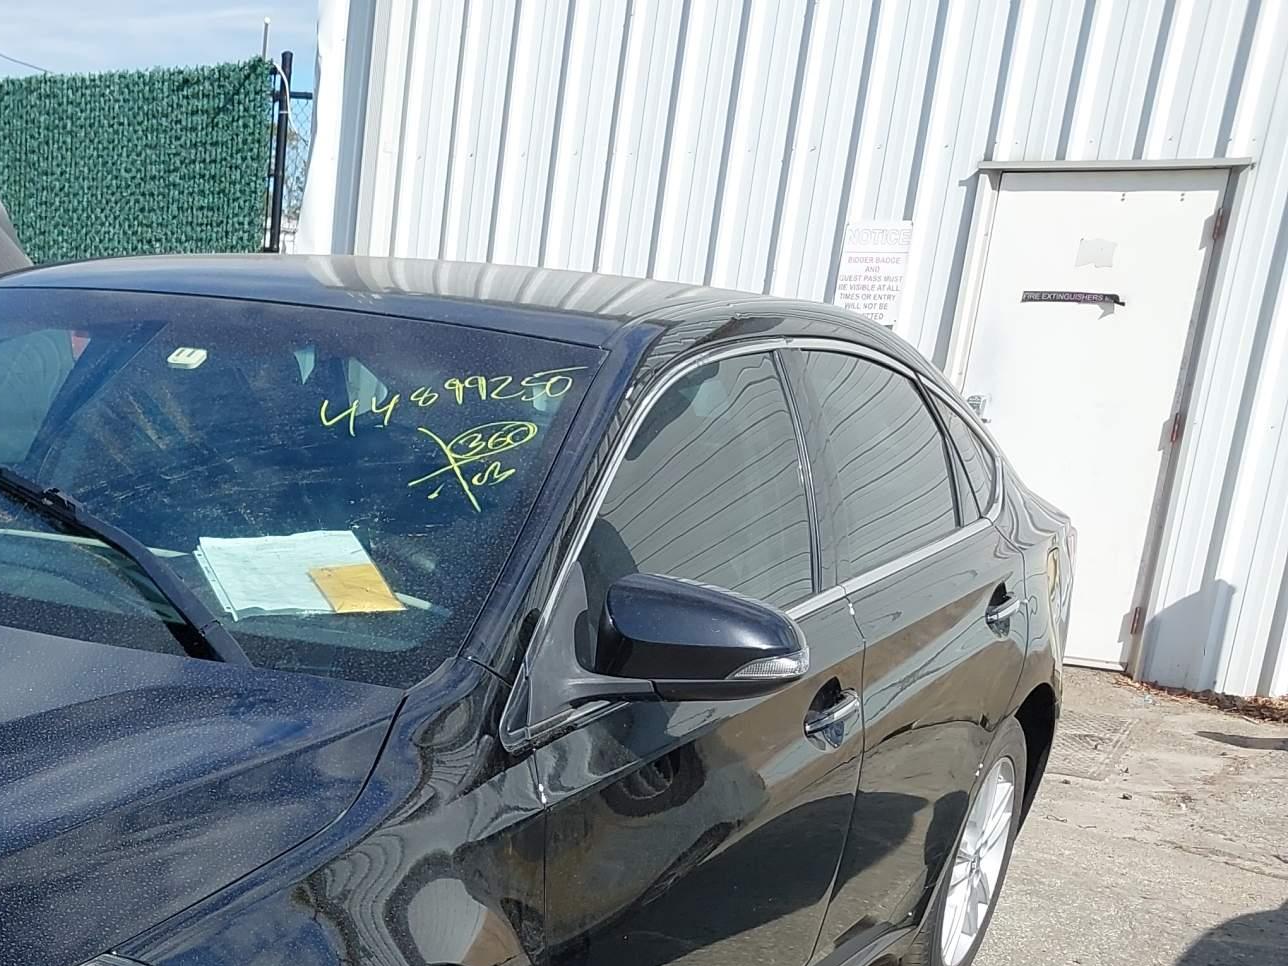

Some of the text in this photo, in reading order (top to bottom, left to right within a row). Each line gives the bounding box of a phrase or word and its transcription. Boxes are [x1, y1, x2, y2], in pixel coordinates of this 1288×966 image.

[847, 228, 912, 246] NOTICE
[847, 256, 901, 264] BIDDER BADGE
[865, 265, 880, 273] AND
[839, 274, 862, 282] GUEST
[883, 275, 903, 283] MUST
[1041, 293, 1103, 301] EXTINGUISHERS
[844, 302, 888, 310] WILL NOT BE
[320, 366, 589, 437] 44899250
